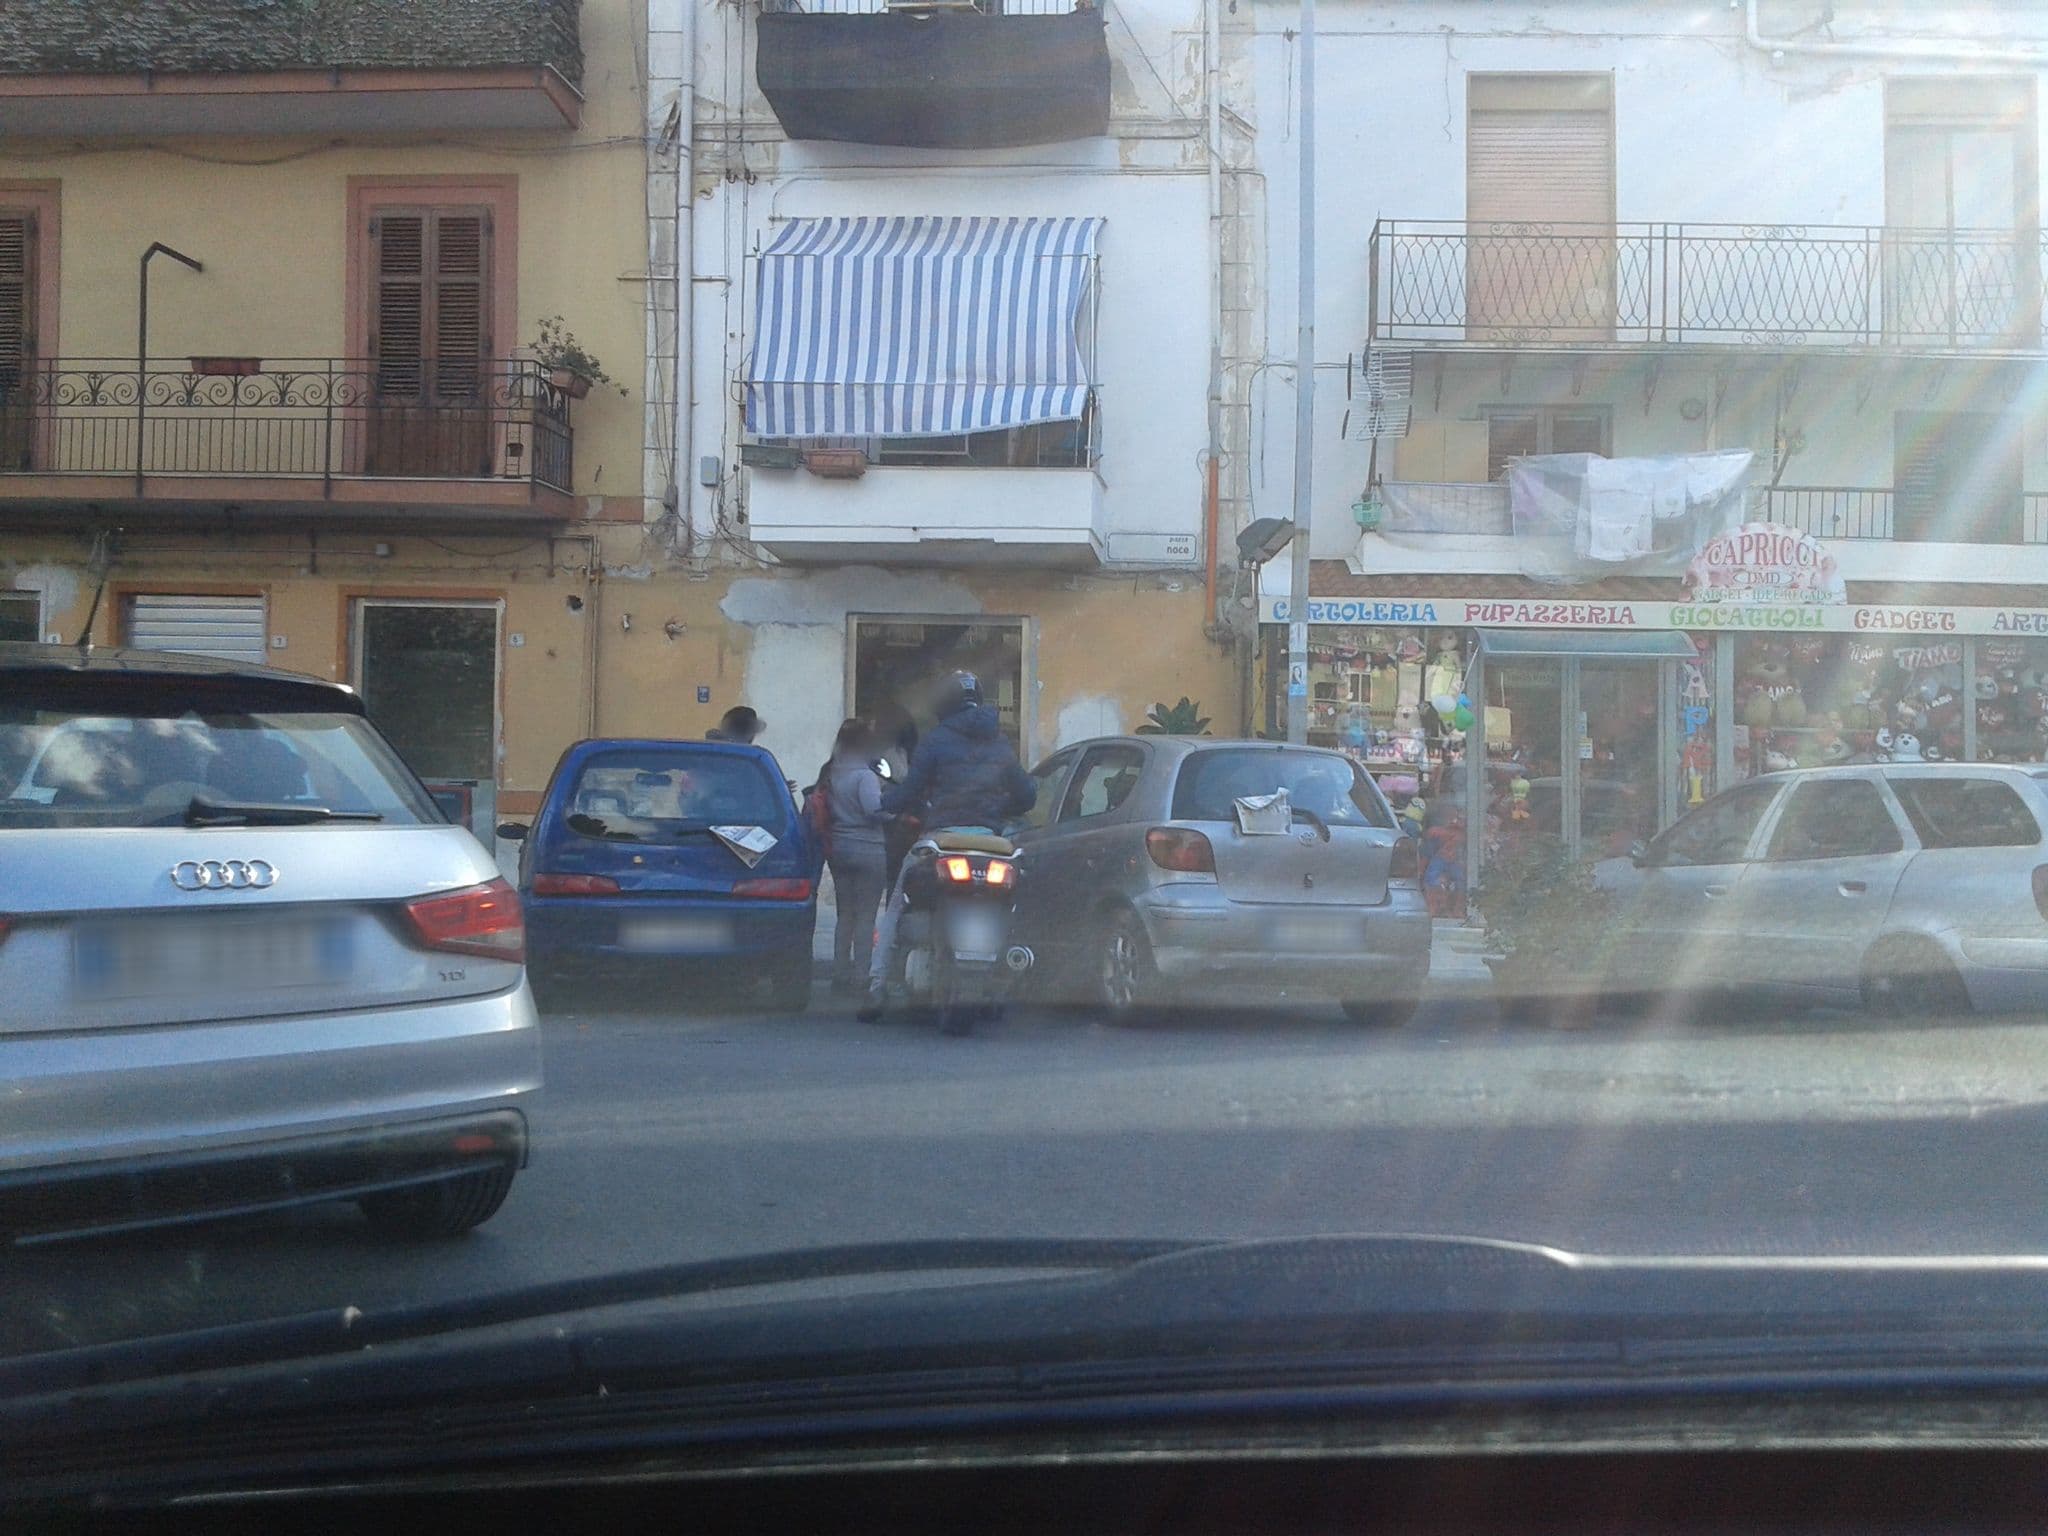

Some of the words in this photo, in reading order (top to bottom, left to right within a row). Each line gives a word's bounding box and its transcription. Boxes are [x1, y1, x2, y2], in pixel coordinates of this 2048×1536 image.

[1166, 545, 1190, 554] noce
[1273, 601, 1437, 622] CRTOLERIA
[1464, 603, 1636, 624] PUPAZZERIA
[1669, 605, 1825, 627] GIOCATTOLI
[1854, 609, 1956, 631] GADGET
